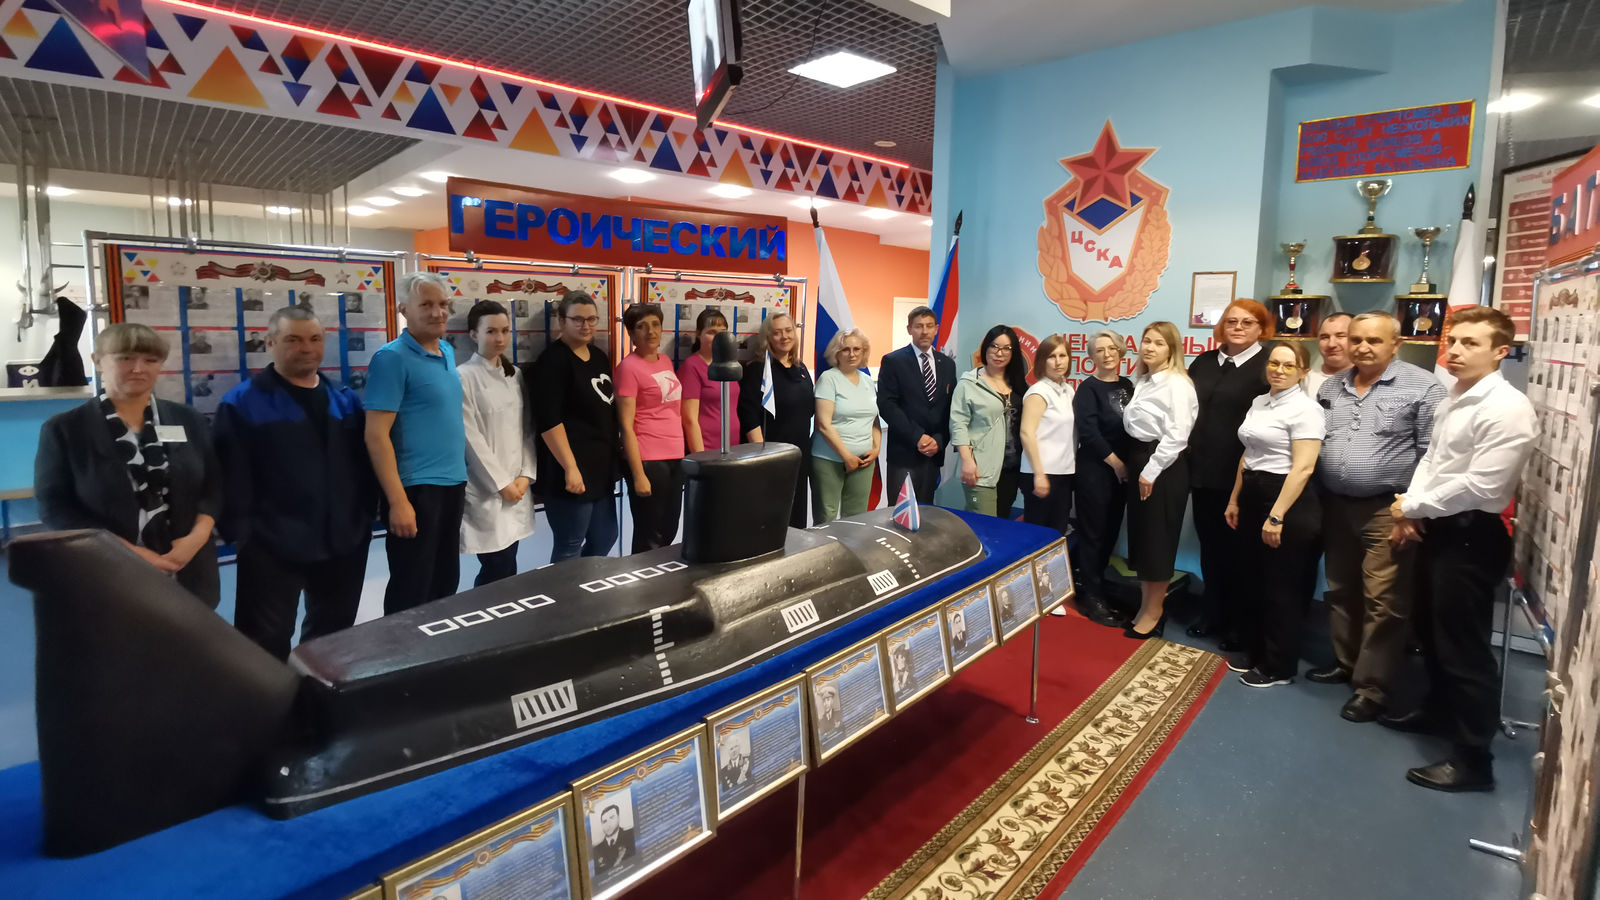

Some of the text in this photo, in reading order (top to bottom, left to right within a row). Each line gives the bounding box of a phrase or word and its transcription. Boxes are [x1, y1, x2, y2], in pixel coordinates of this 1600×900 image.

[1383, 115, 1470, 134] НЕСКОЛЬКИХ
[450, 195, 786, 260] ГЕРОИЧЕСКИЙ
[1071, 230, 1123, 268] ЦСКА
